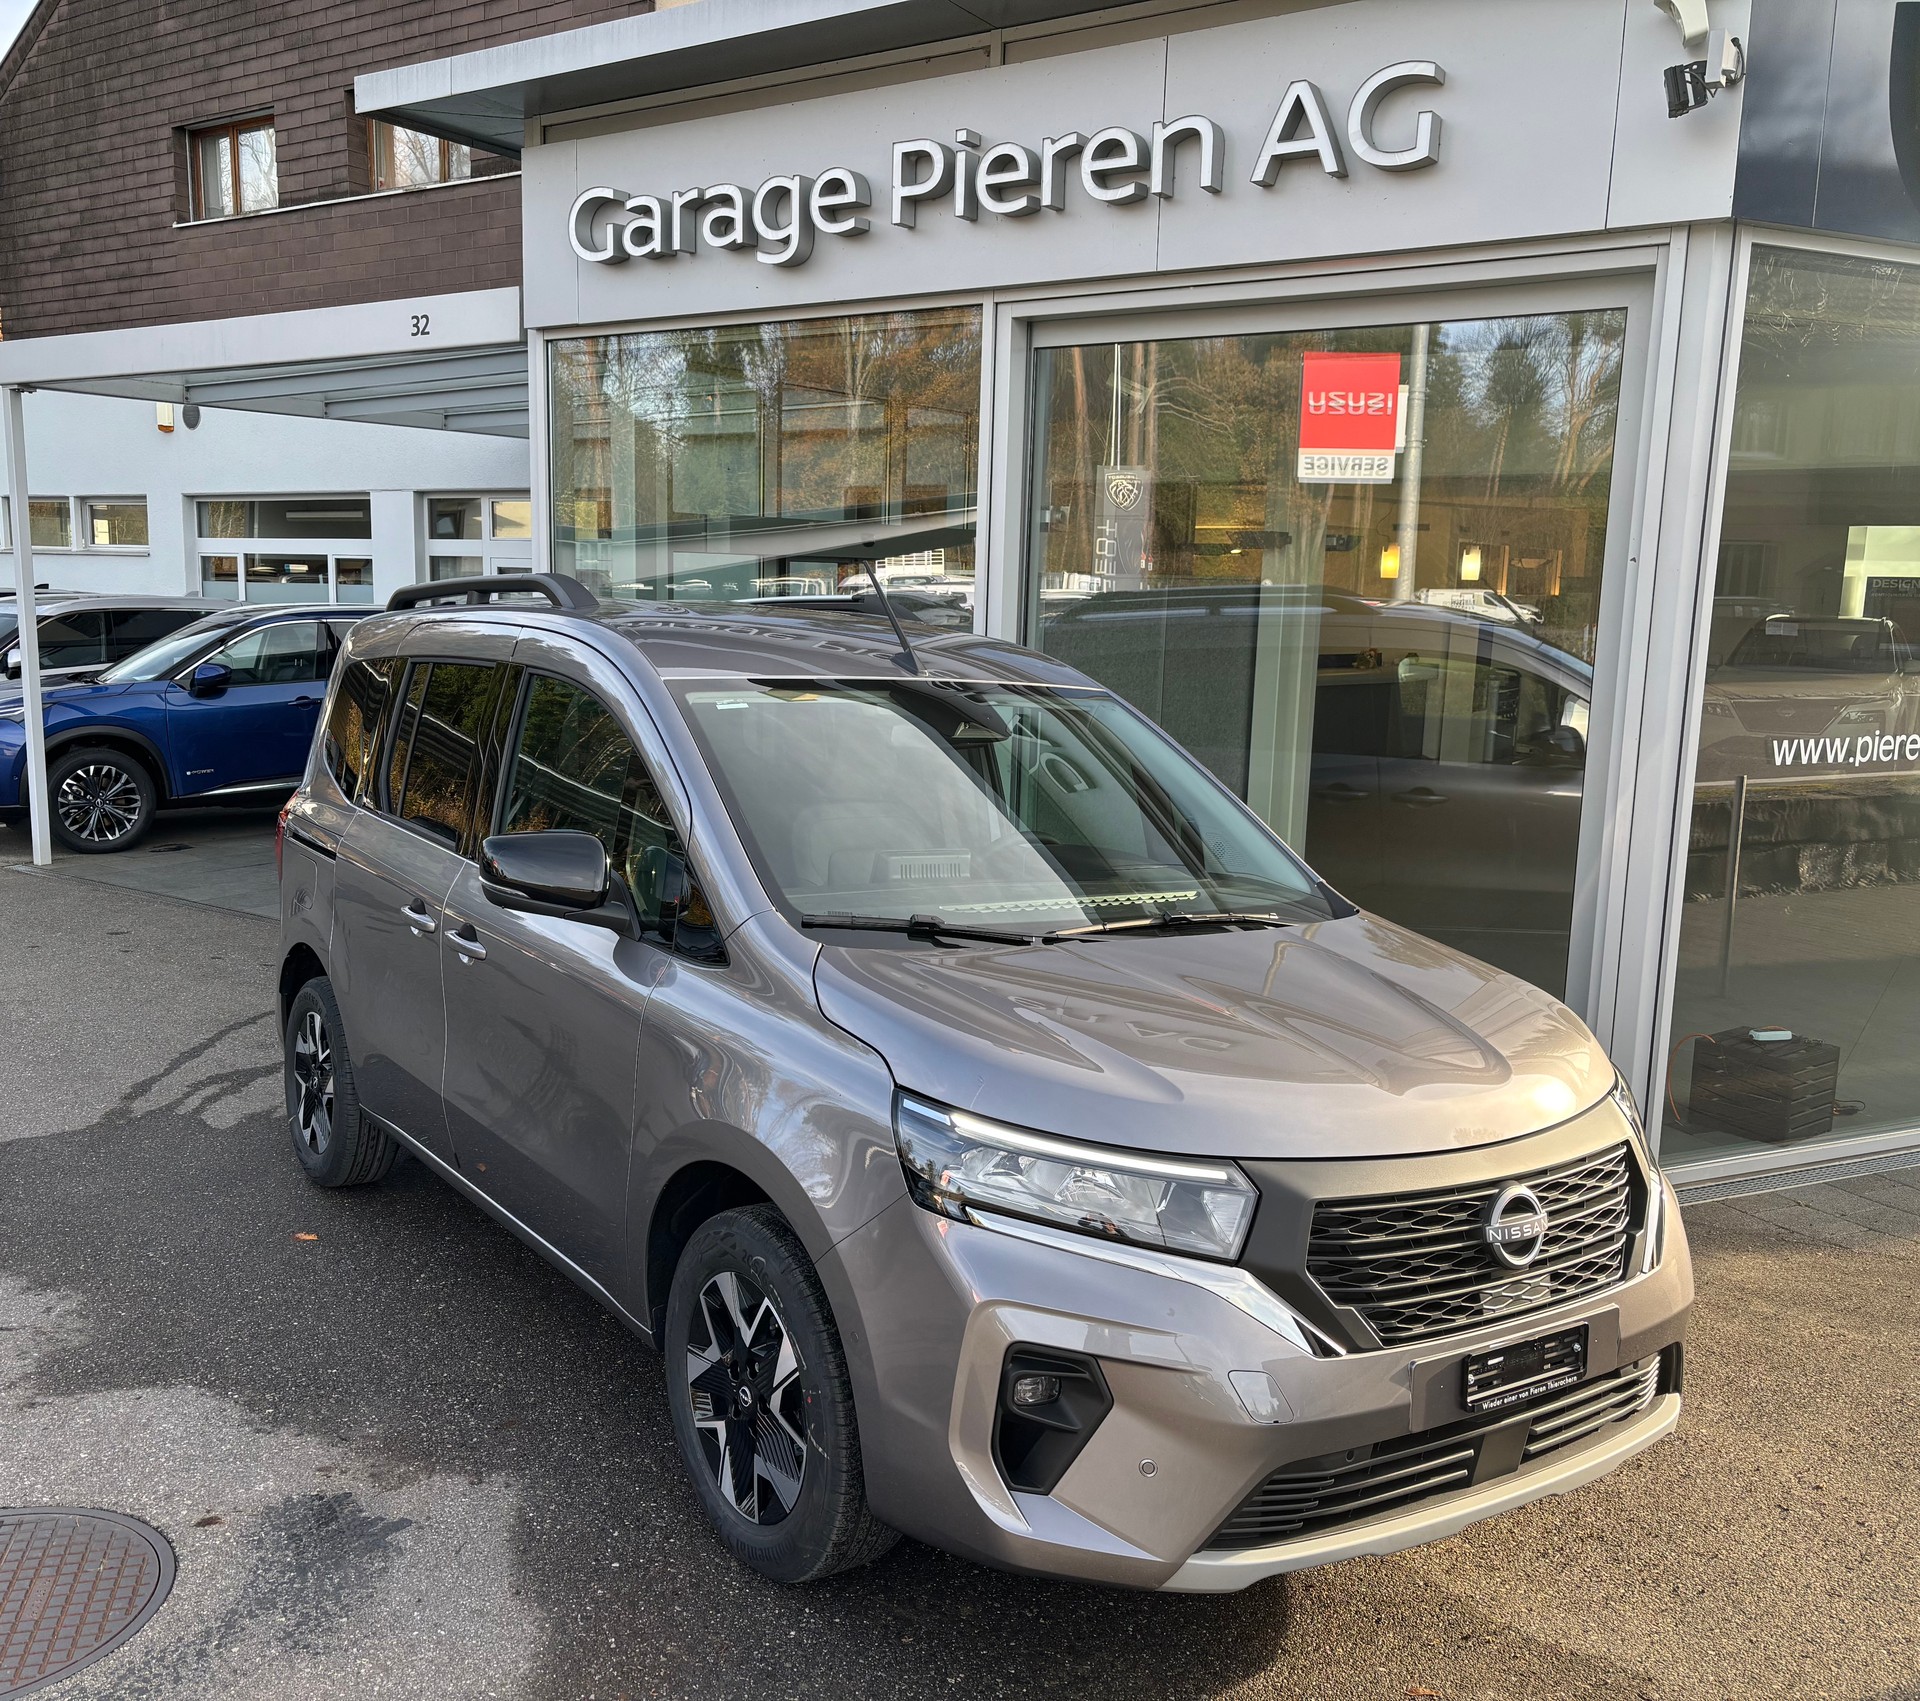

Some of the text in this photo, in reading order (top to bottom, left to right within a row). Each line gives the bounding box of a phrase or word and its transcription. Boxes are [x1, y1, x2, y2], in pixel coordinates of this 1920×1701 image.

[569, 60, 1446, 267] Garage Pieren AG
[411, 314, 430, 337] 32
[1773, 729, 1920, 767] www.piere
[1489, 1218, 1547, 1241] NISSAN
[1482, 1397, 1503, 1410] Wieder
[1504, 1393, 1518, 1404] einer
[1519, 1391, 1529, 1399] von
[1530, 1385, 1547, 1396] Pieren
